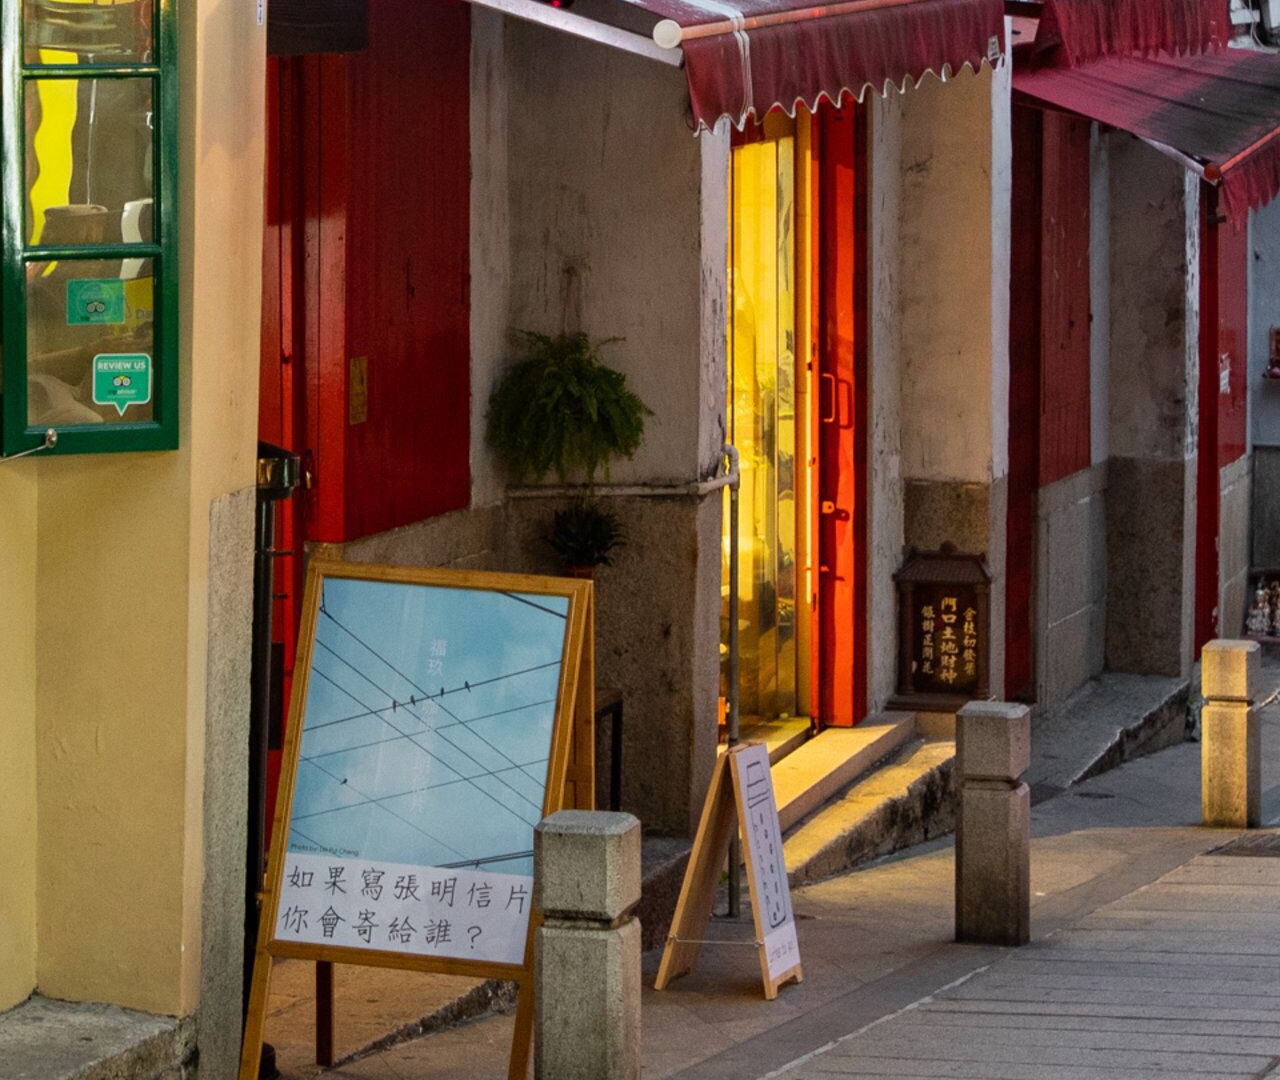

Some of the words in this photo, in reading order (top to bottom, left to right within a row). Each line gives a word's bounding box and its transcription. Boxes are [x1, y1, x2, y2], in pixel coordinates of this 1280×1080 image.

[97, 360, 131, 370] REVIEW
[134, 360, 146, 370] US
[940, 597, 959, 683] 門口土地財神
[287, 865, 528, 914] 如果寫張明信片
